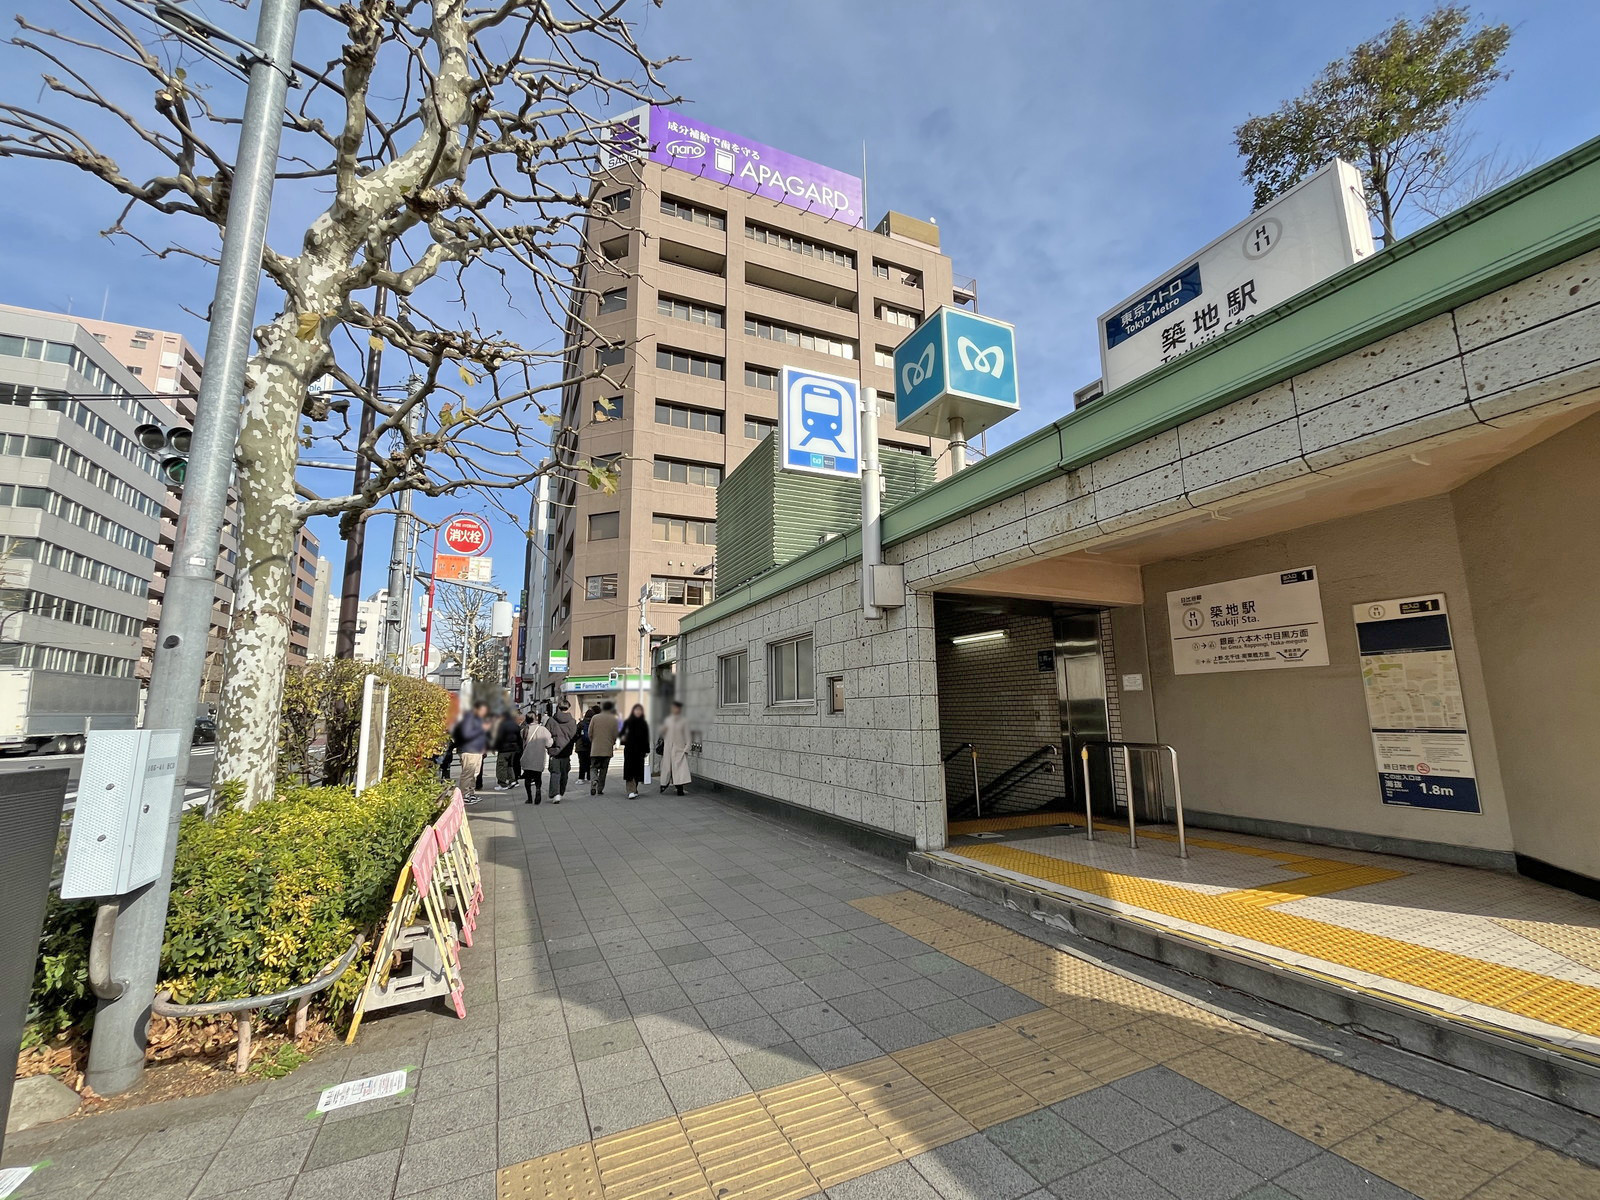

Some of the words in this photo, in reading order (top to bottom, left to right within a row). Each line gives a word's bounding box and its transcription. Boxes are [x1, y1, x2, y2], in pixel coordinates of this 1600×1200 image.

[667, 121, 760, 161] 成分補給で歯を守る
[671, 144, 702, 155] nano
[740, 160, 849, 211] APAGARD
[1255, 224, 1267, 240] H
[1253, 235, 1271, 252] 11
[1120, 279, 1183, 328] 東京メトロ
[1124, 315, 1151, 335] Tokyo
[1151, 297, 1180, 319] Metro
[1160, 279, 1258, 354] 築地駅
[449, 528, 482, 544] 消火栓
[1301, 571, 1308, 580] 1
[1210, 600, 1256, 619] 築地駅
[1425, 600, 1433, 610] 1
[1188, 618, 1198, 627] 11
[1189, 611, 1196, 619] H
[1211, 616, 1239, 628] Tsukiji
[1241, 615, 1260, 624] Sta.
[1384, 773, 1422, 781] この出入口は
[1419, 782, 1454, 797] 1.8m
